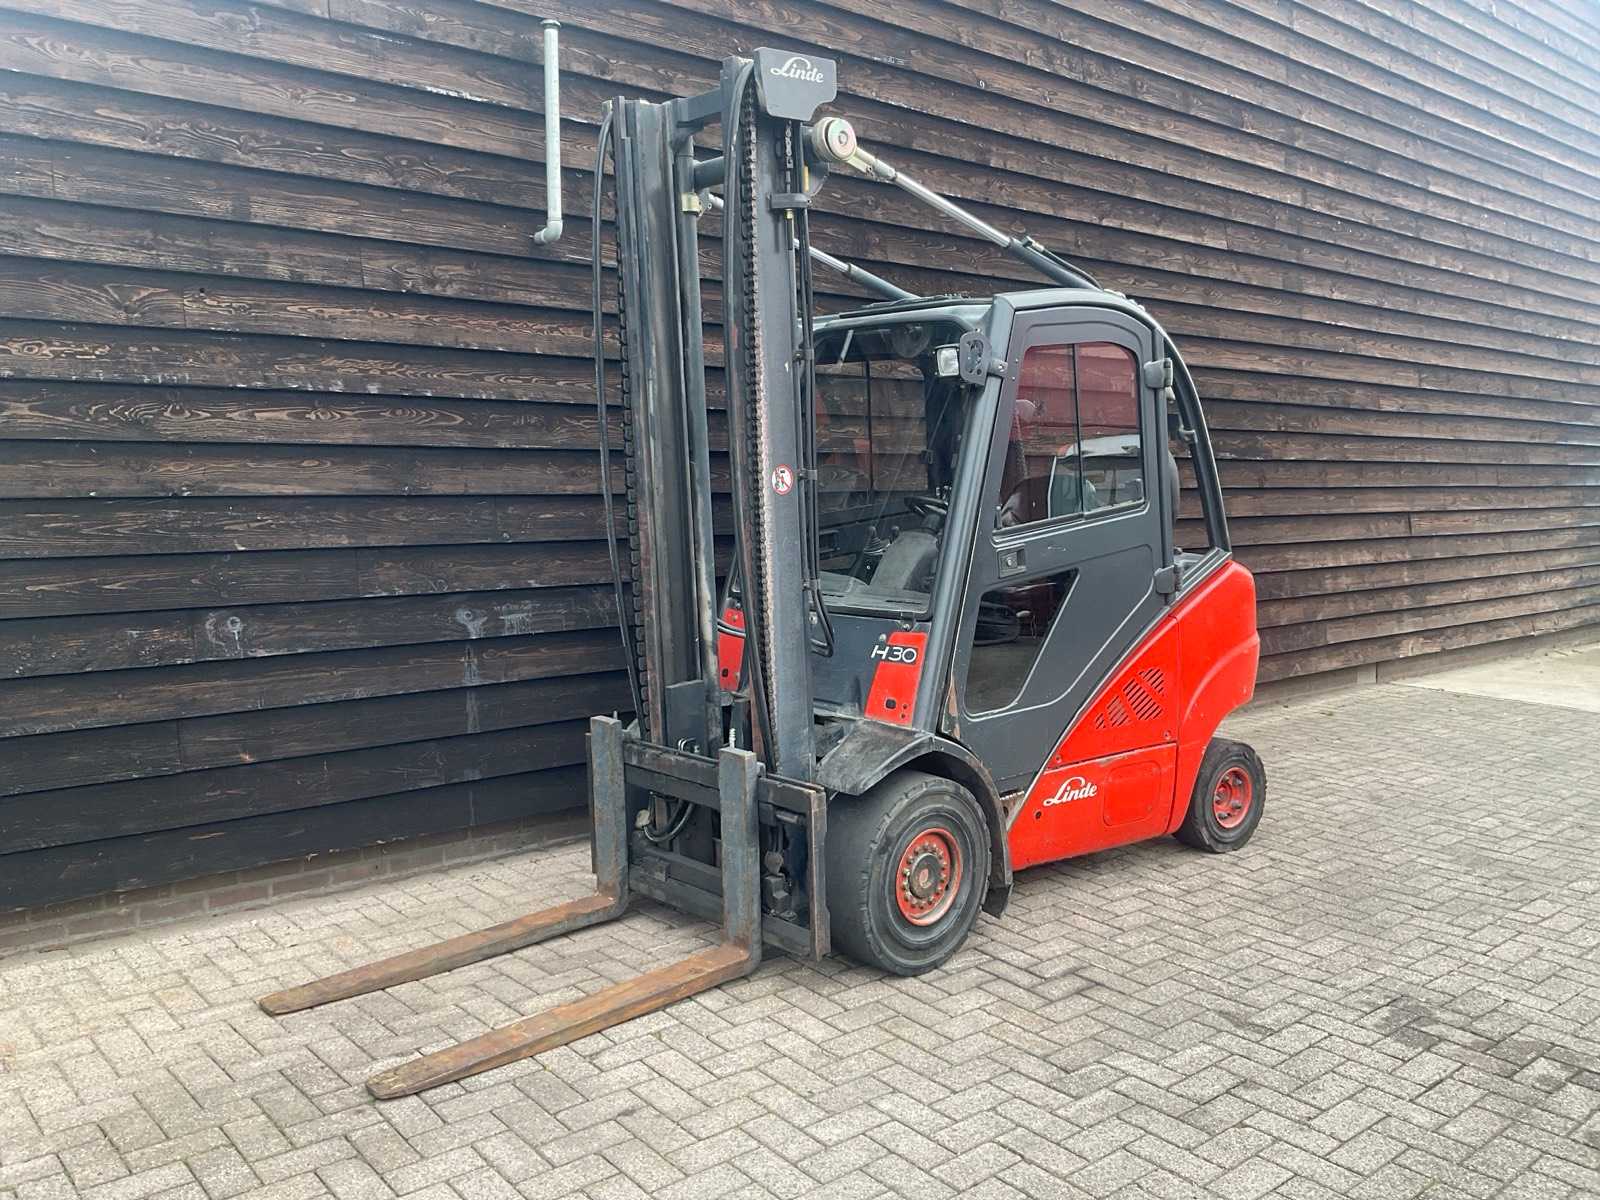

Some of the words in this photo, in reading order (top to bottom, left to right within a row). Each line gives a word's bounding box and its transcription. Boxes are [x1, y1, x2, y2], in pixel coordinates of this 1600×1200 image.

[770, 56, 824, 83] Linde
[870, 644, 917, 663] H30
[1043, 776, 1098, 807] Linde
